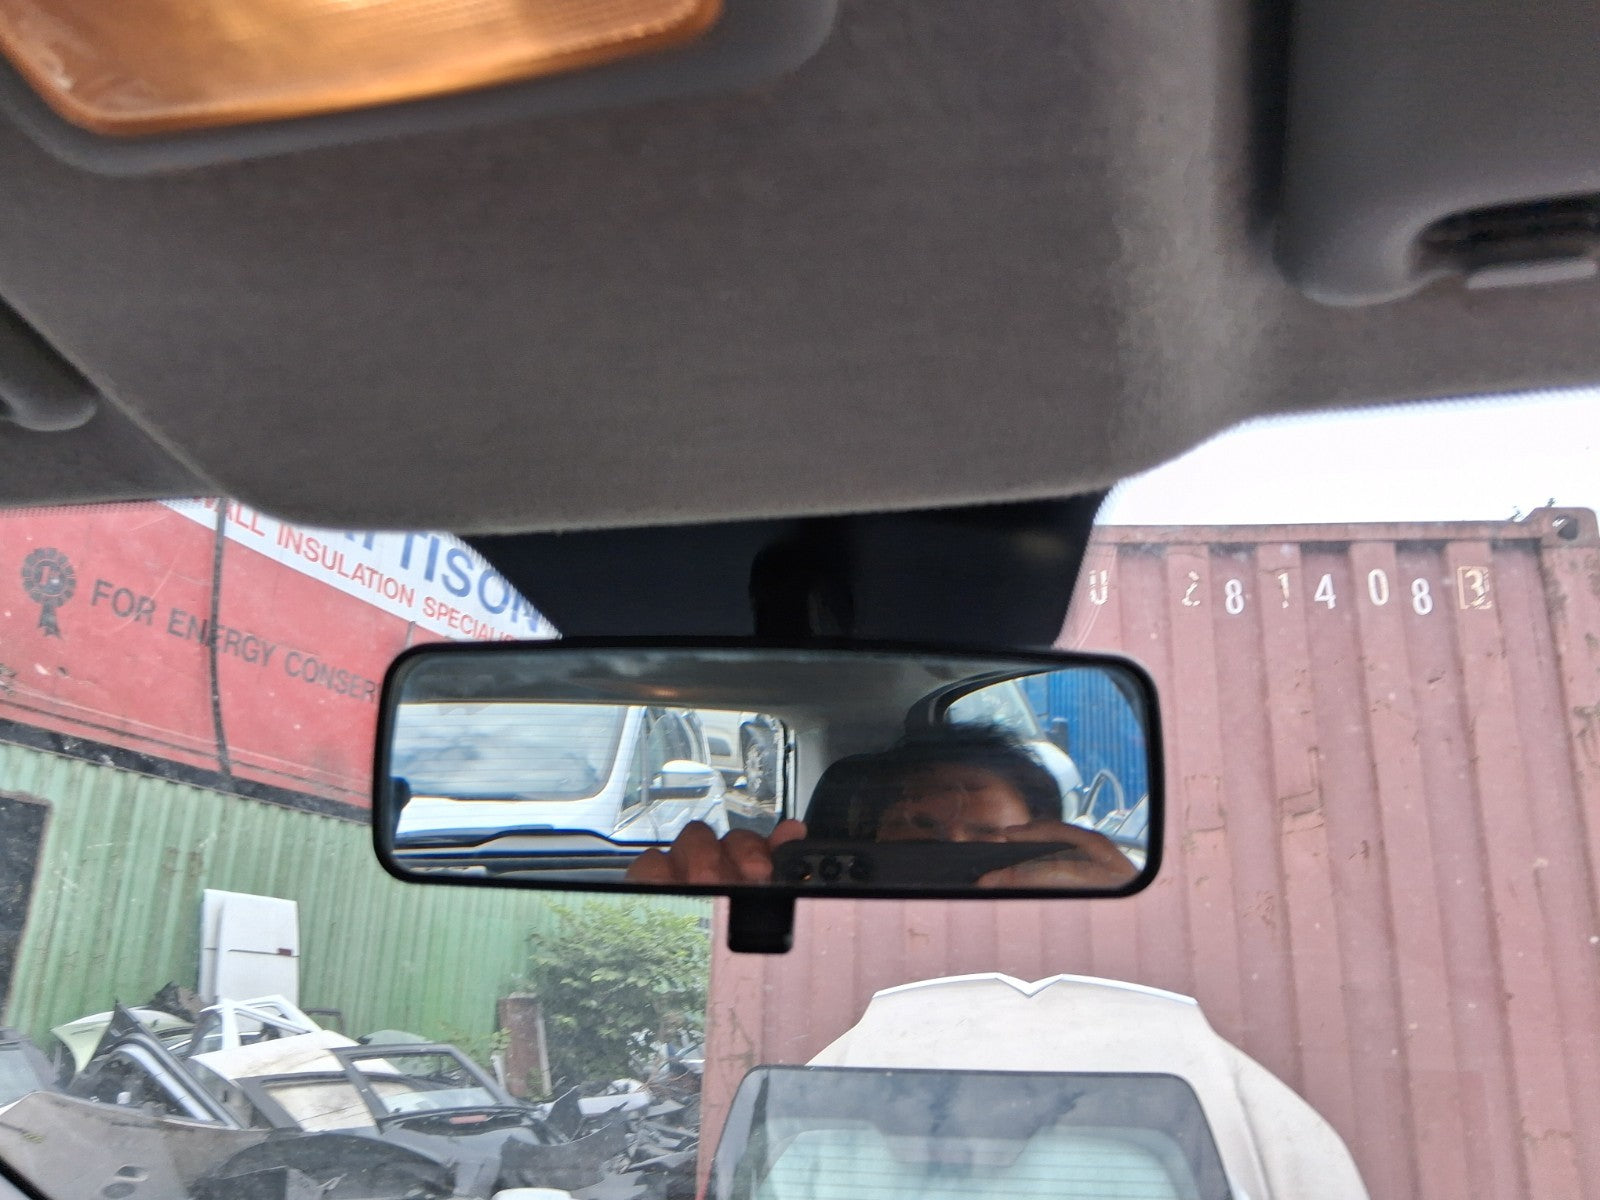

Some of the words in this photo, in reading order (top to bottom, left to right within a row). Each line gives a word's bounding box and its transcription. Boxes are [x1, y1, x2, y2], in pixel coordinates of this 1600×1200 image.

[276, 521, 415, 608] INSULATION
[422, 596, 513, 640] SPECIAL
[344, 530, 538, 632] TISON
[1462, 567, 1487, 608] 3
[91, 579, 156, 626] FOR
[167, 607, 277, 667] ENERGY
[284, 651, 381, 702] CONSER
